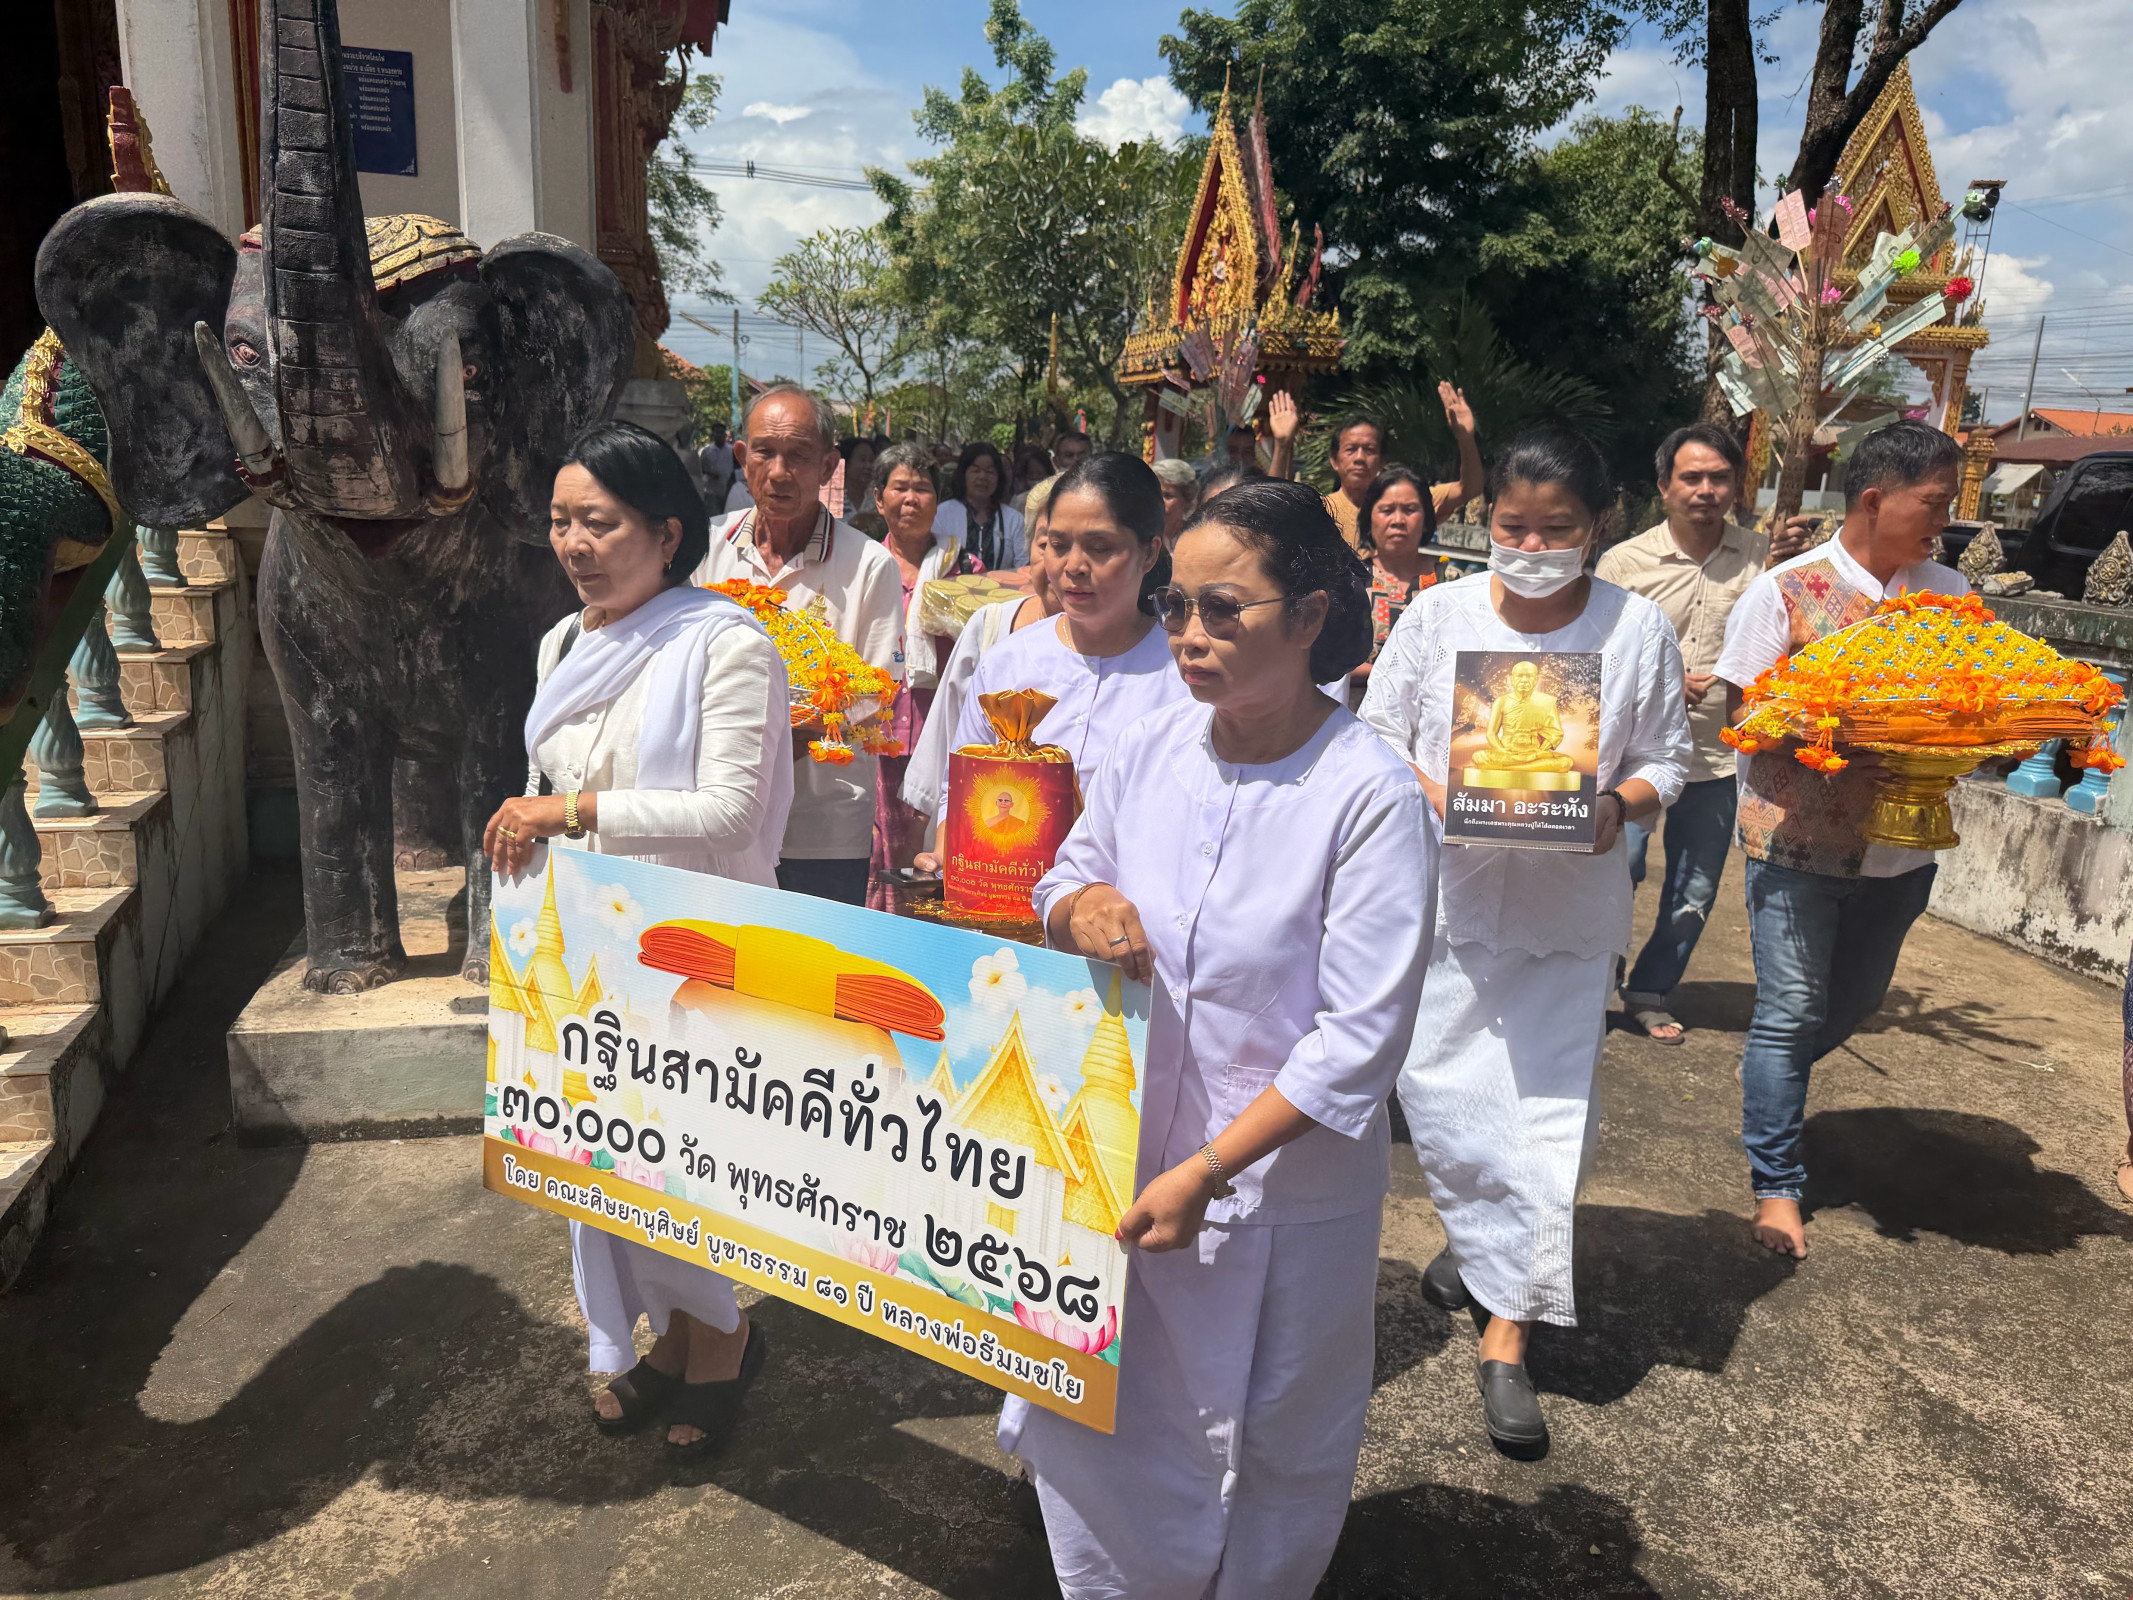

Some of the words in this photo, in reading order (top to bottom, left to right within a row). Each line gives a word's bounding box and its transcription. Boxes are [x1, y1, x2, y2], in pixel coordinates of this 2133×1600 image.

[1453, 792, 1506, 814] สัมมา
[1514, 797, 1589, 818] อะระหัง
[951, 853, 1050, 878] กฐินสามัคคีทั่วไ
[979, 878, 988, 888] วัด
[562, 1009, 1026, 1200] กฐินสามัคคีทั่วไทย
[502, 1085, 666, 1164] ๓๐,๐๐๐
[679, 1133, 716, 1183] วัด
[727, 1162, 907, 1249] พุทธศักราช
[924, 1213, 1101, 1323] ๒๕๖๘
[503, 1157, 539, 1189] โดย
[546, 1177, 699, 1246] คณะศิษยานุศิษย์
[707, 1234, 807, 1288] บูชาธรรม
[816, 1278, 847, 1304] ๘๑
[857, 1284, 873, 1313] ปี
[883, 1302, 1082, 1400] หลวงพ่อธัมมชโย
